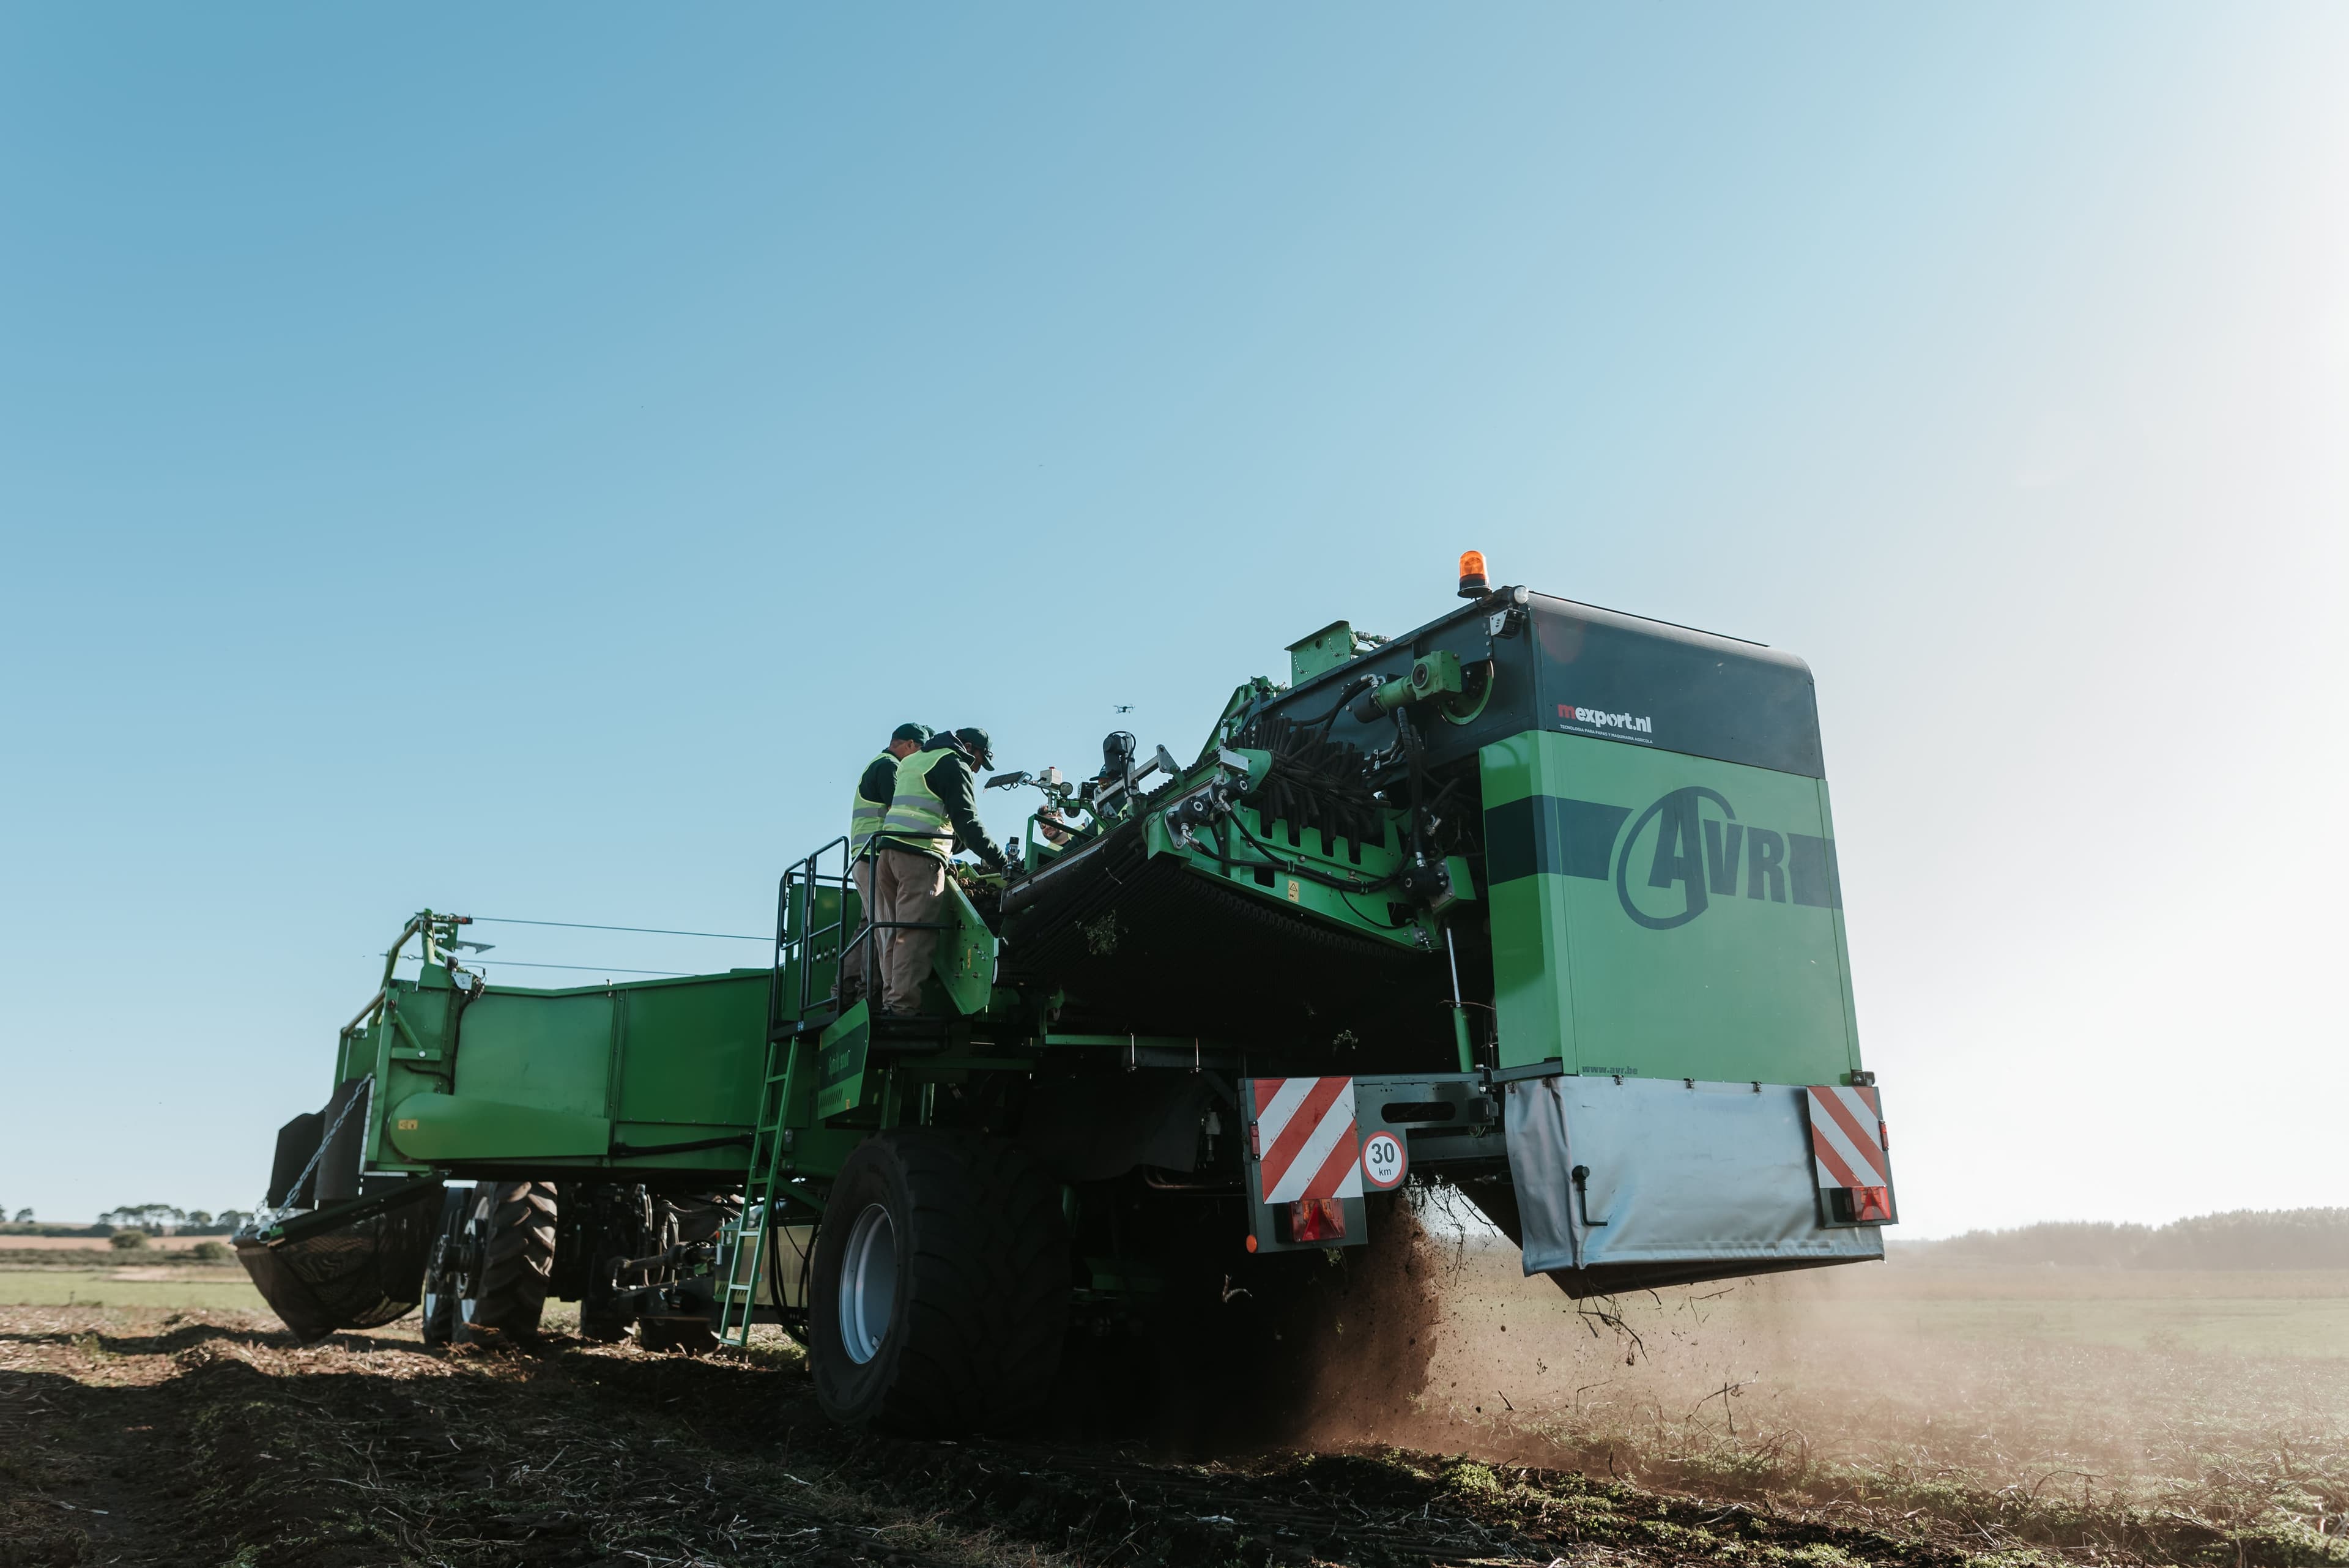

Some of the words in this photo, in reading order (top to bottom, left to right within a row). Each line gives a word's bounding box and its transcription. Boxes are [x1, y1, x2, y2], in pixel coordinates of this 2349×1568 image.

[1558, 704, 1652, 733] mexport.nl
[1560, 724, 1584, 732] TECNOLOGIA
[1617, 786, 1787, 930] AVR
[1582, 1066, 1638, 1075] www.avr.be
[1371, 1142, 1395, 1164] 30
[1378, 1167, 1392, 1176] km
